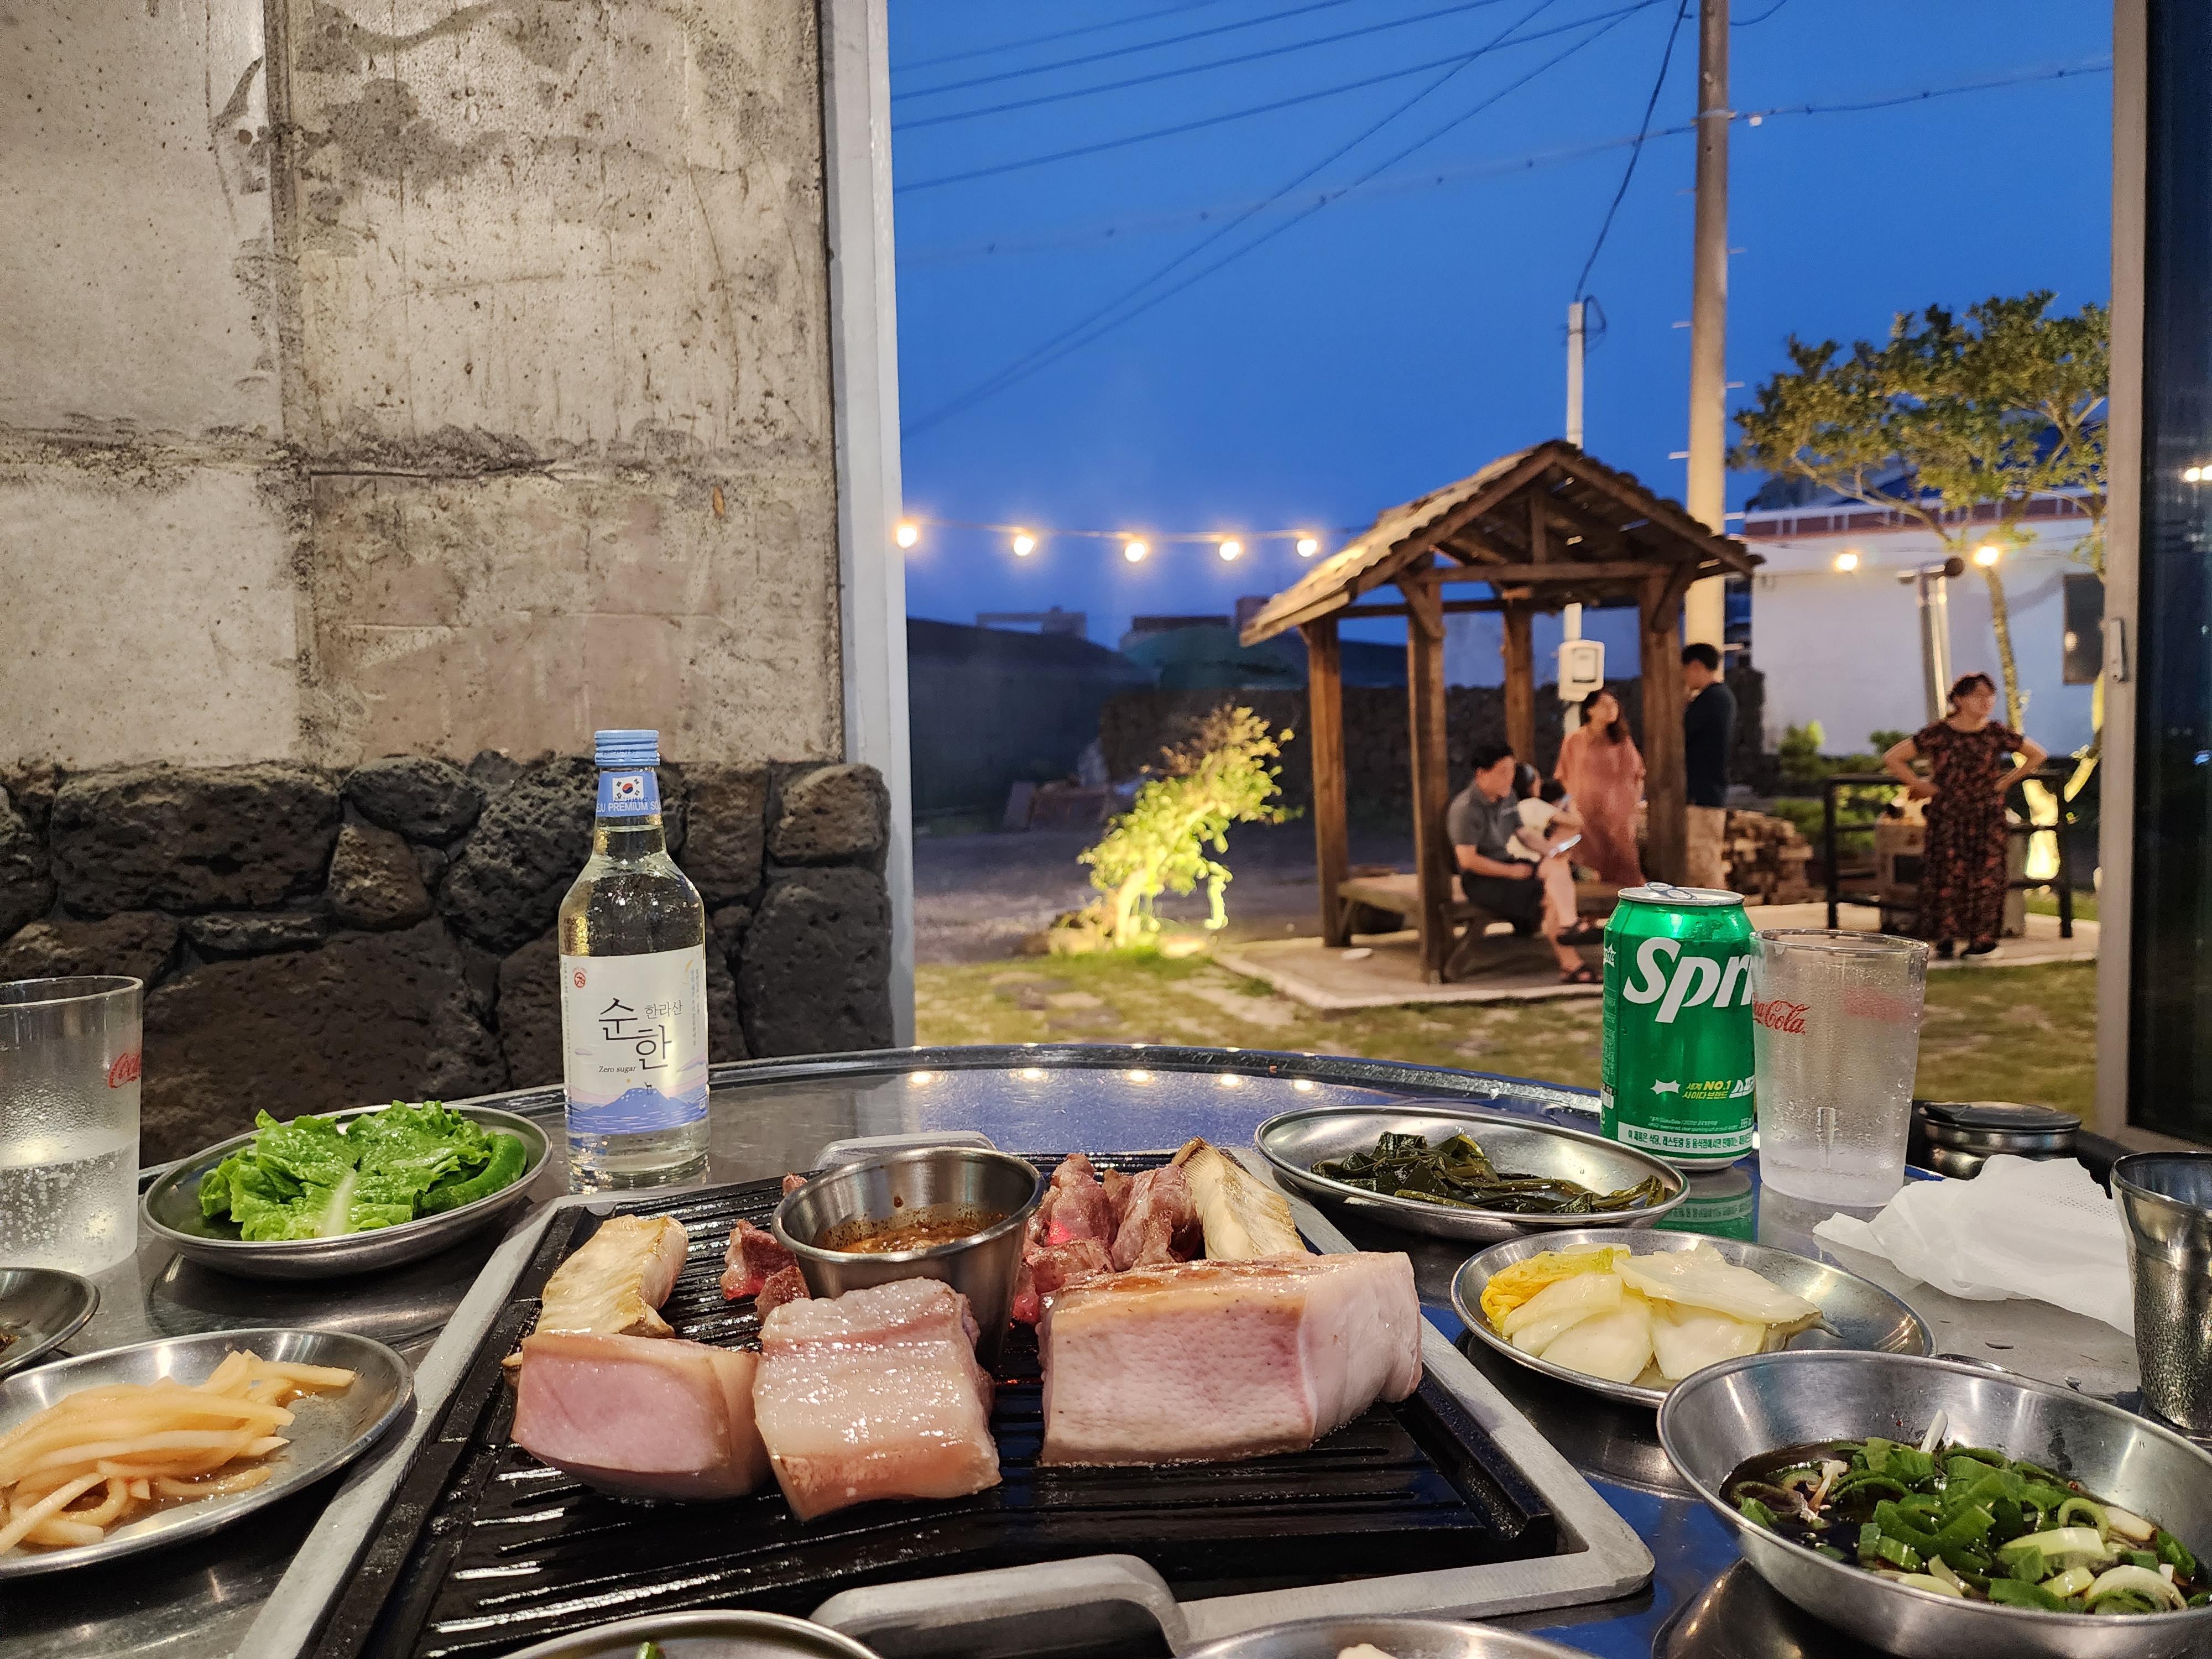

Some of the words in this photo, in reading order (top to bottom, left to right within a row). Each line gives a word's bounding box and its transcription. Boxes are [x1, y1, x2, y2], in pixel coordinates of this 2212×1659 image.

[608, 802, 649, 812] PREMIUM
[644, 999, 683, 1020] 한라산
[1703, 1079, 1732, 1091] NO.1
[1682, 1091, 1707, 1099] 사이다
[1706, 1091, 1729, 1099] 브랜드
[1628, 1129, 1633, 1139] 이
[1686, 1138, 1691, 1149] 등
